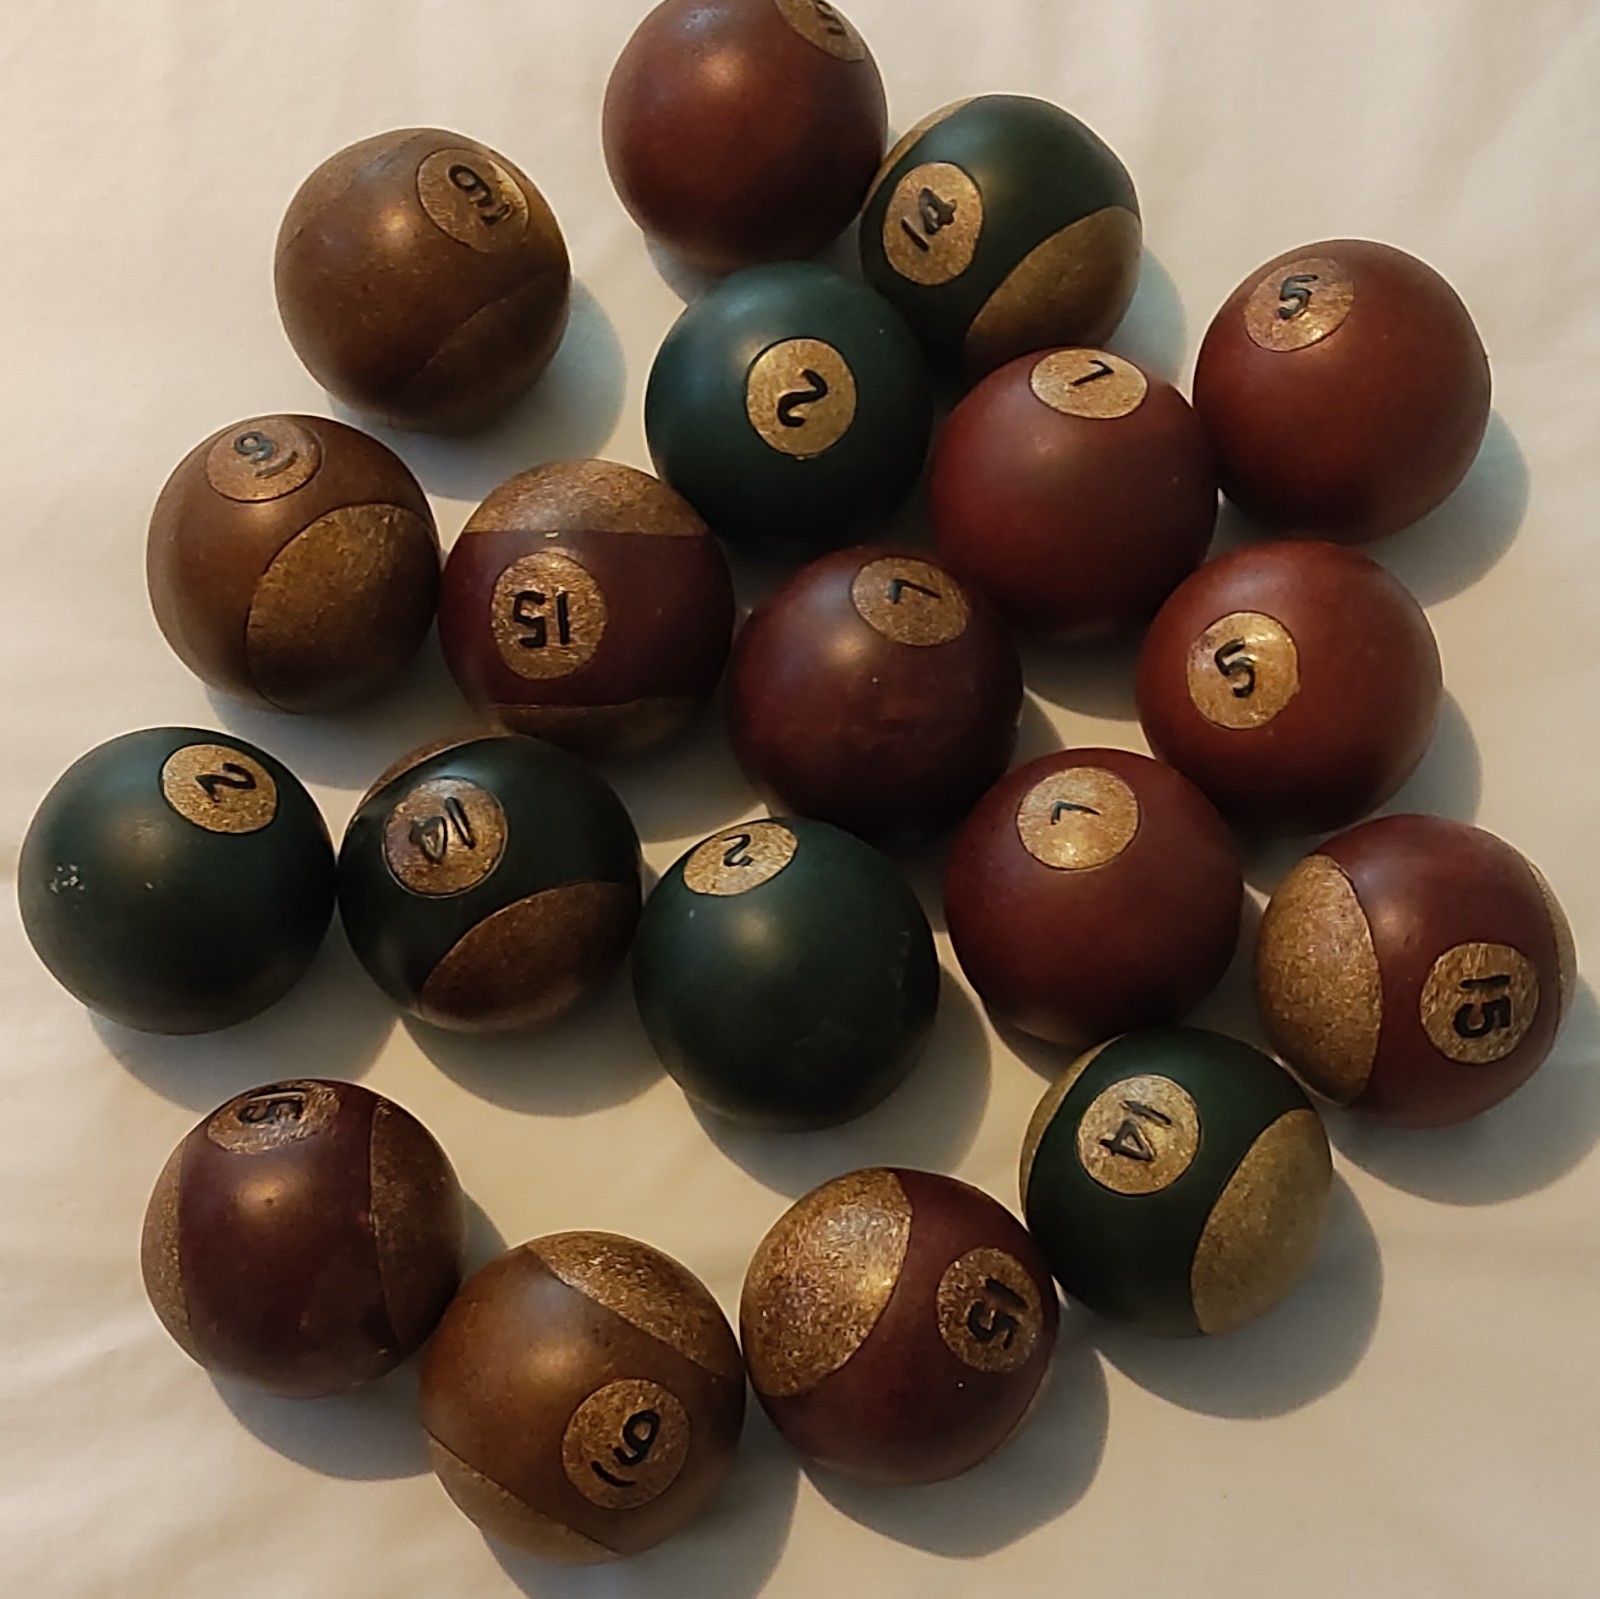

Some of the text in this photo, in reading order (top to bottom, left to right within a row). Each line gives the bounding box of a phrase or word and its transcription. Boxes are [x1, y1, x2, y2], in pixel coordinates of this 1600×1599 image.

[900, 186, 957, 252] 14
[1279, 273, 1318, 320] 5
[776, 368, 828, 428] 2
[1070, 358, 1115, 387] 7
[512, 589, 570, 649] 15
[887, 578, 942, 606] 7
[1214, 637, 1257, 698] 5
[194, 762, 257, 803] 2
[409, 796, 476, 865] 14
[1051, 801, 1101, 825] 7
[722, 834, 754, 867] 2
[1452, 974, 1512, 1039] 15
[1099, 1099, 1173, 1163] 14
[966, 1277, 1030, 1350] 15
